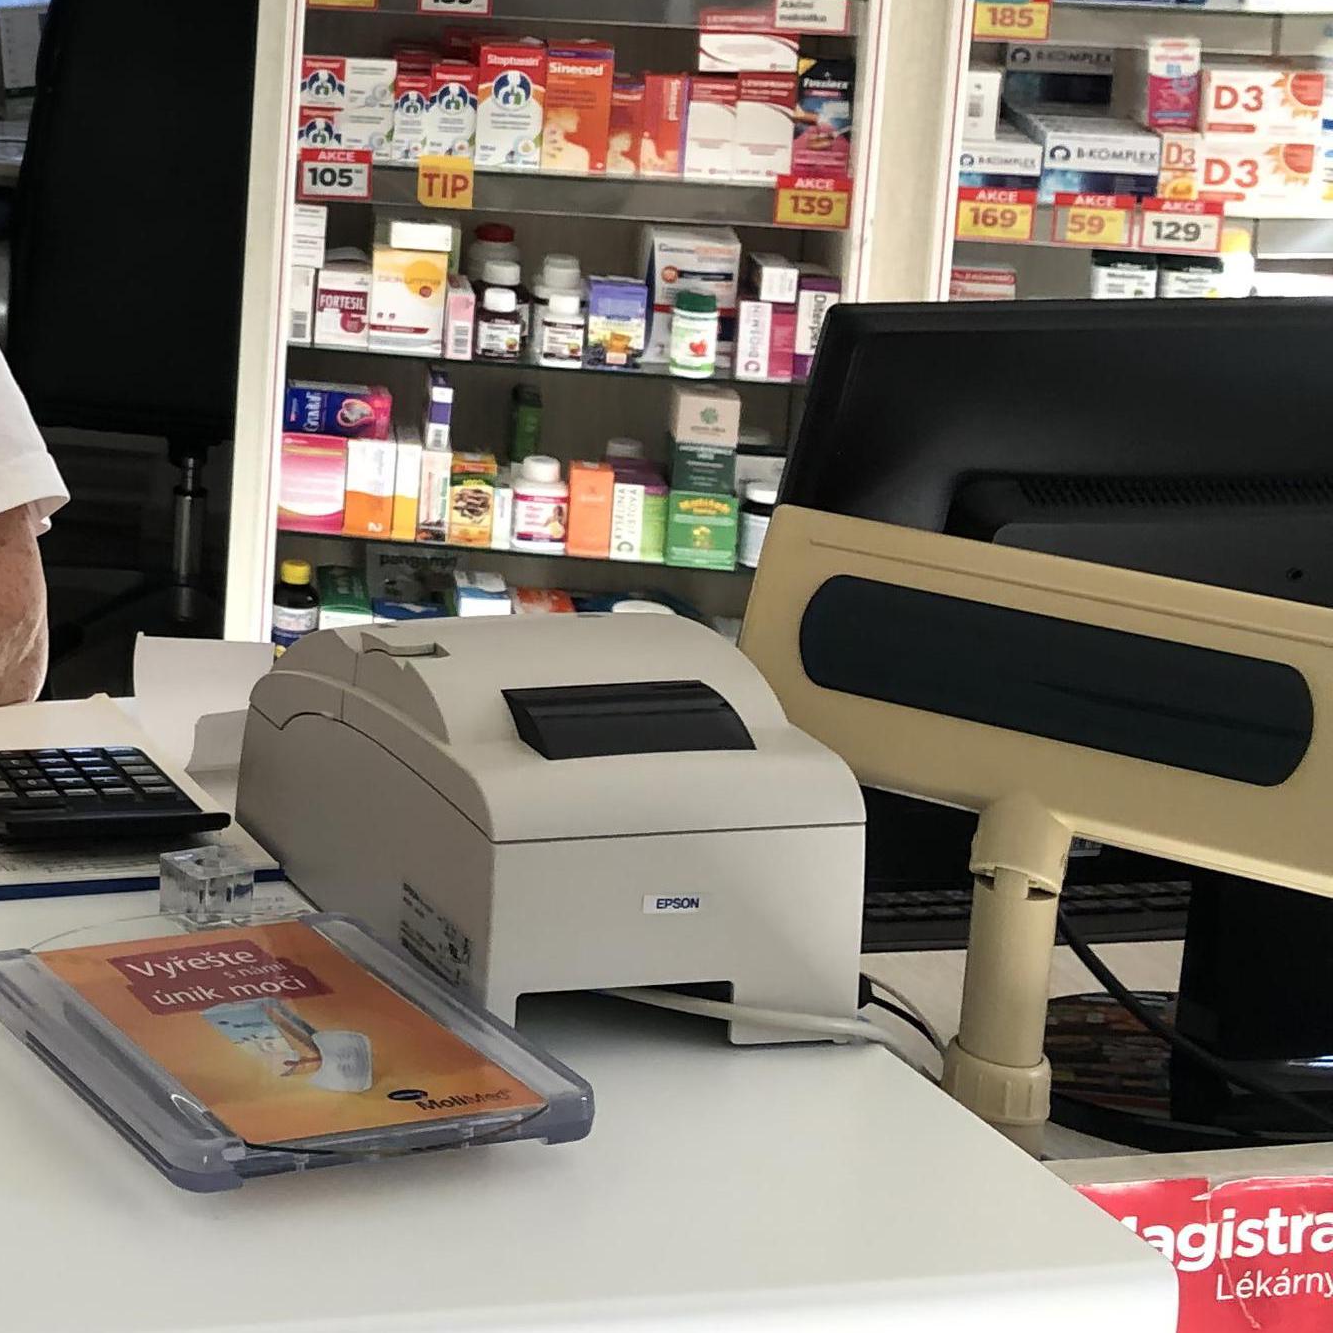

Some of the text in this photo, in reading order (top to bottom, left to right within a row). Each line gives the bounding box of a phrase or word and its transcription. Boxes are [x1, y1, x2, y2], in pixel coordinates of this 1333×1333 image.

[986, 6, 1034, 26] 185
[549, 62, 604, 77] Sinecod
[1213, 85, 1263, 110] D3
[317, 151, 356, 162] AKCE
[1076, 148, 1158, 161] B-KOMPLEX
[1164, 143, 1197, 166] D3
[307, 168, 354, 188] 105
[1202, 159, 1260, 187] D3
[422, 171, 469, 199] TIP
[789, 197, 833, 216] 139
[975, 191, 1019, 203] AKCE
[1161, 202, 1205, 213] AKCE
[969, 208, 1017, 228] 169
[1067, 214, 1104, 234] 59
[1151, 220, 1202, 242] 129
[319, 295, 367, 309] FORTESIL
[656, 897, 701, 909] EPSON
[126, 947, 263, 987] Vyřešte
[151, 972, 308, 1011] únik moči
[1216, 1269, 1333, 1301] Lékárny
